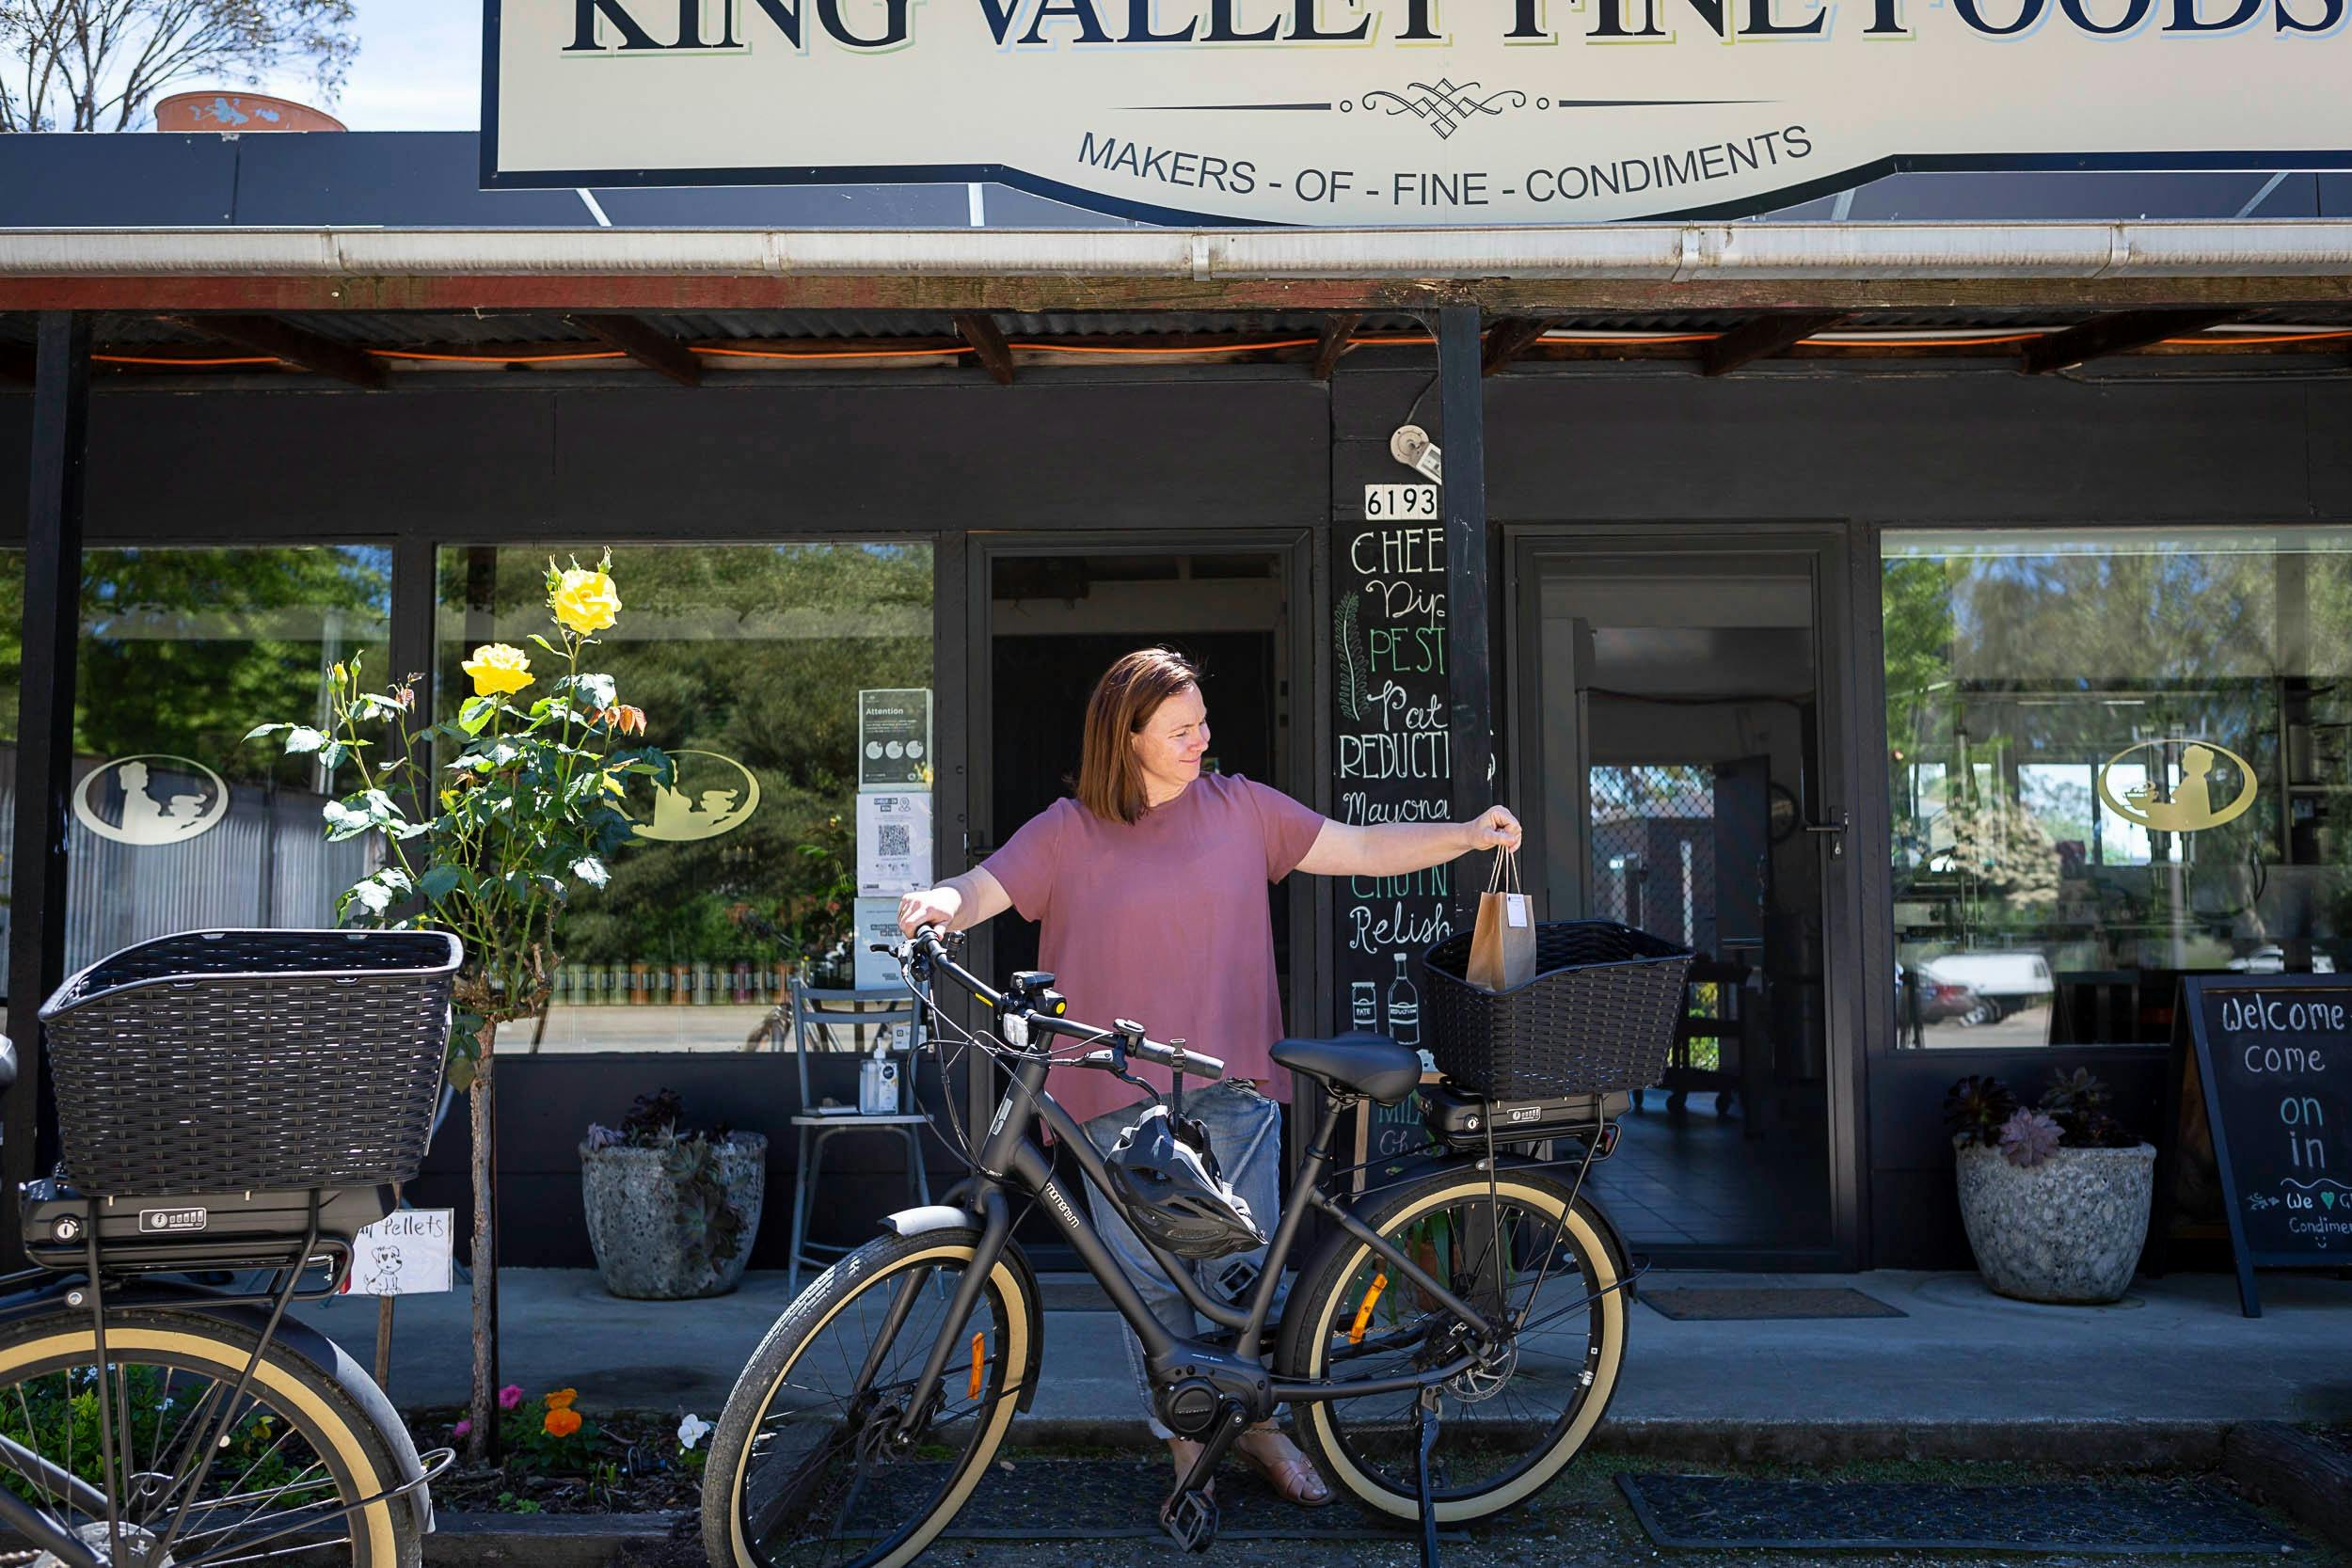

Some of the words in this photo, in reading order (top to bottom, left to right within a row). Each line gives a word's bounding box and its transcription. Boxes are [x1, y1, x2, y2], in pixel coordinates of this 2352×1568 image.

[1077, 131, 1257, 195] MAKERS
[1295, 168, 1355, 202] OF
[1393, 172, 1489, 206] FINE
[1525, 124, 1813, 203] CONDIMENTS
[1366, 487, 1436, 516] 6193
[866, 706, 904, 716] Attention
[1349, 900, 1450, 955] Relish
[2221, 992, 2344, 1032] Welcome
[2244, 1045, 2327, 1073] come
[2280, 1096, 2324, 1127] on
[2288, 1131, 2326, 1169] in
[1045, 1180, 1081, 1229] momentum
[2286, 1192, 2313, 1209] We
[380, 1214, 445, 1238] Pellets
[2288, 1215, 2352, 1234] Condime
